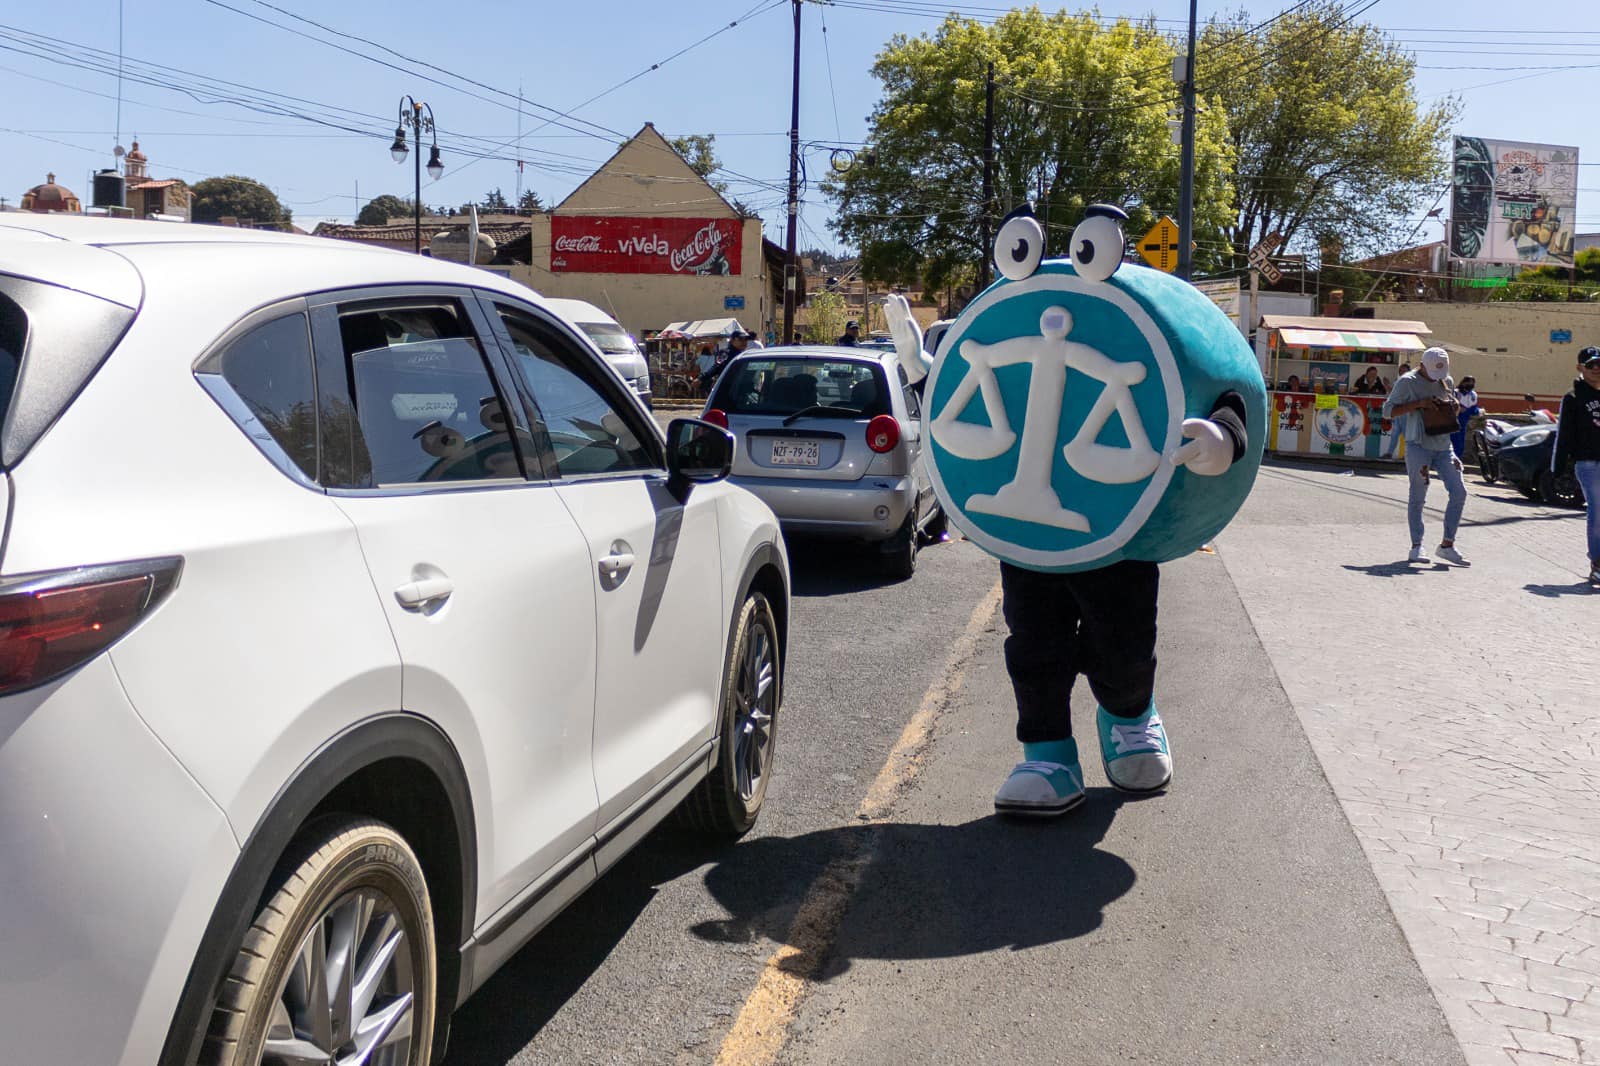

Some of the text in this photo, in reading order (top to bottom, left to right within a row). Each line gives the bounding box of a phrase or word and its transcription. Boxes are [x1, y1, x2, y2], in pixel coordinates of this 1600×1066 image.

[1502, 202, 1533, 220] LETY
[555, 235, 602, 252] Coca-Cola
[671, 220, 722, 272] Coca-Cola
